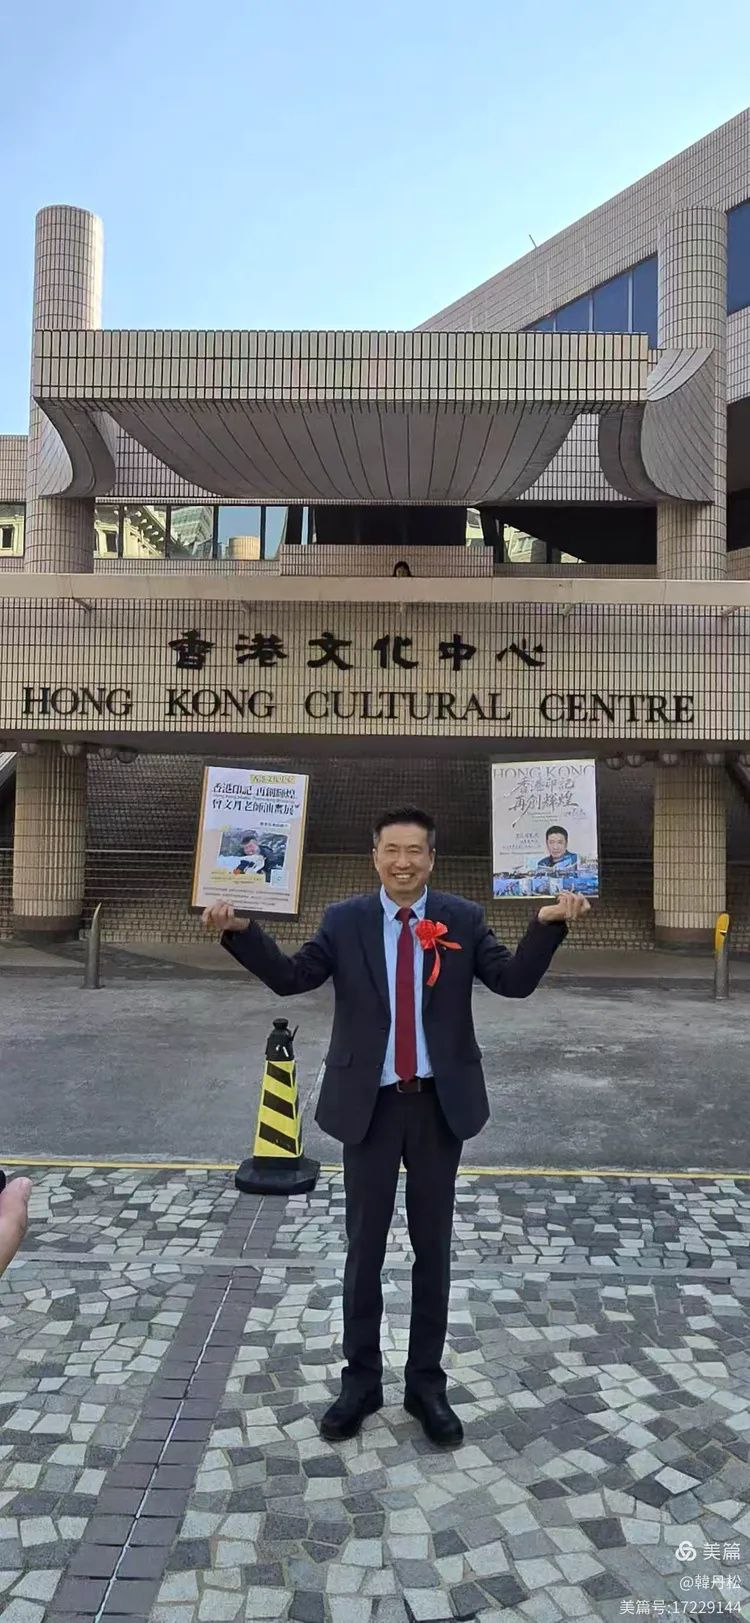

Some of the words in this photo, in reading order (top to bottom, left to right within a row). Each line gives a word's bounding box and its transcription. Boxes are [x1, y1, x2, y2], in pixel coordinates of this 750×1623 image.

[168, 629, 546, 671] 香港文化中心
[21, 686, 133, 717] HONG
[164, 688, 275, 719] KONG
[303, 690, 511, 722] CULTURAL
[539, 693, 695, 724] CENTRE
[212, 782, 253, 796] 香港印記
